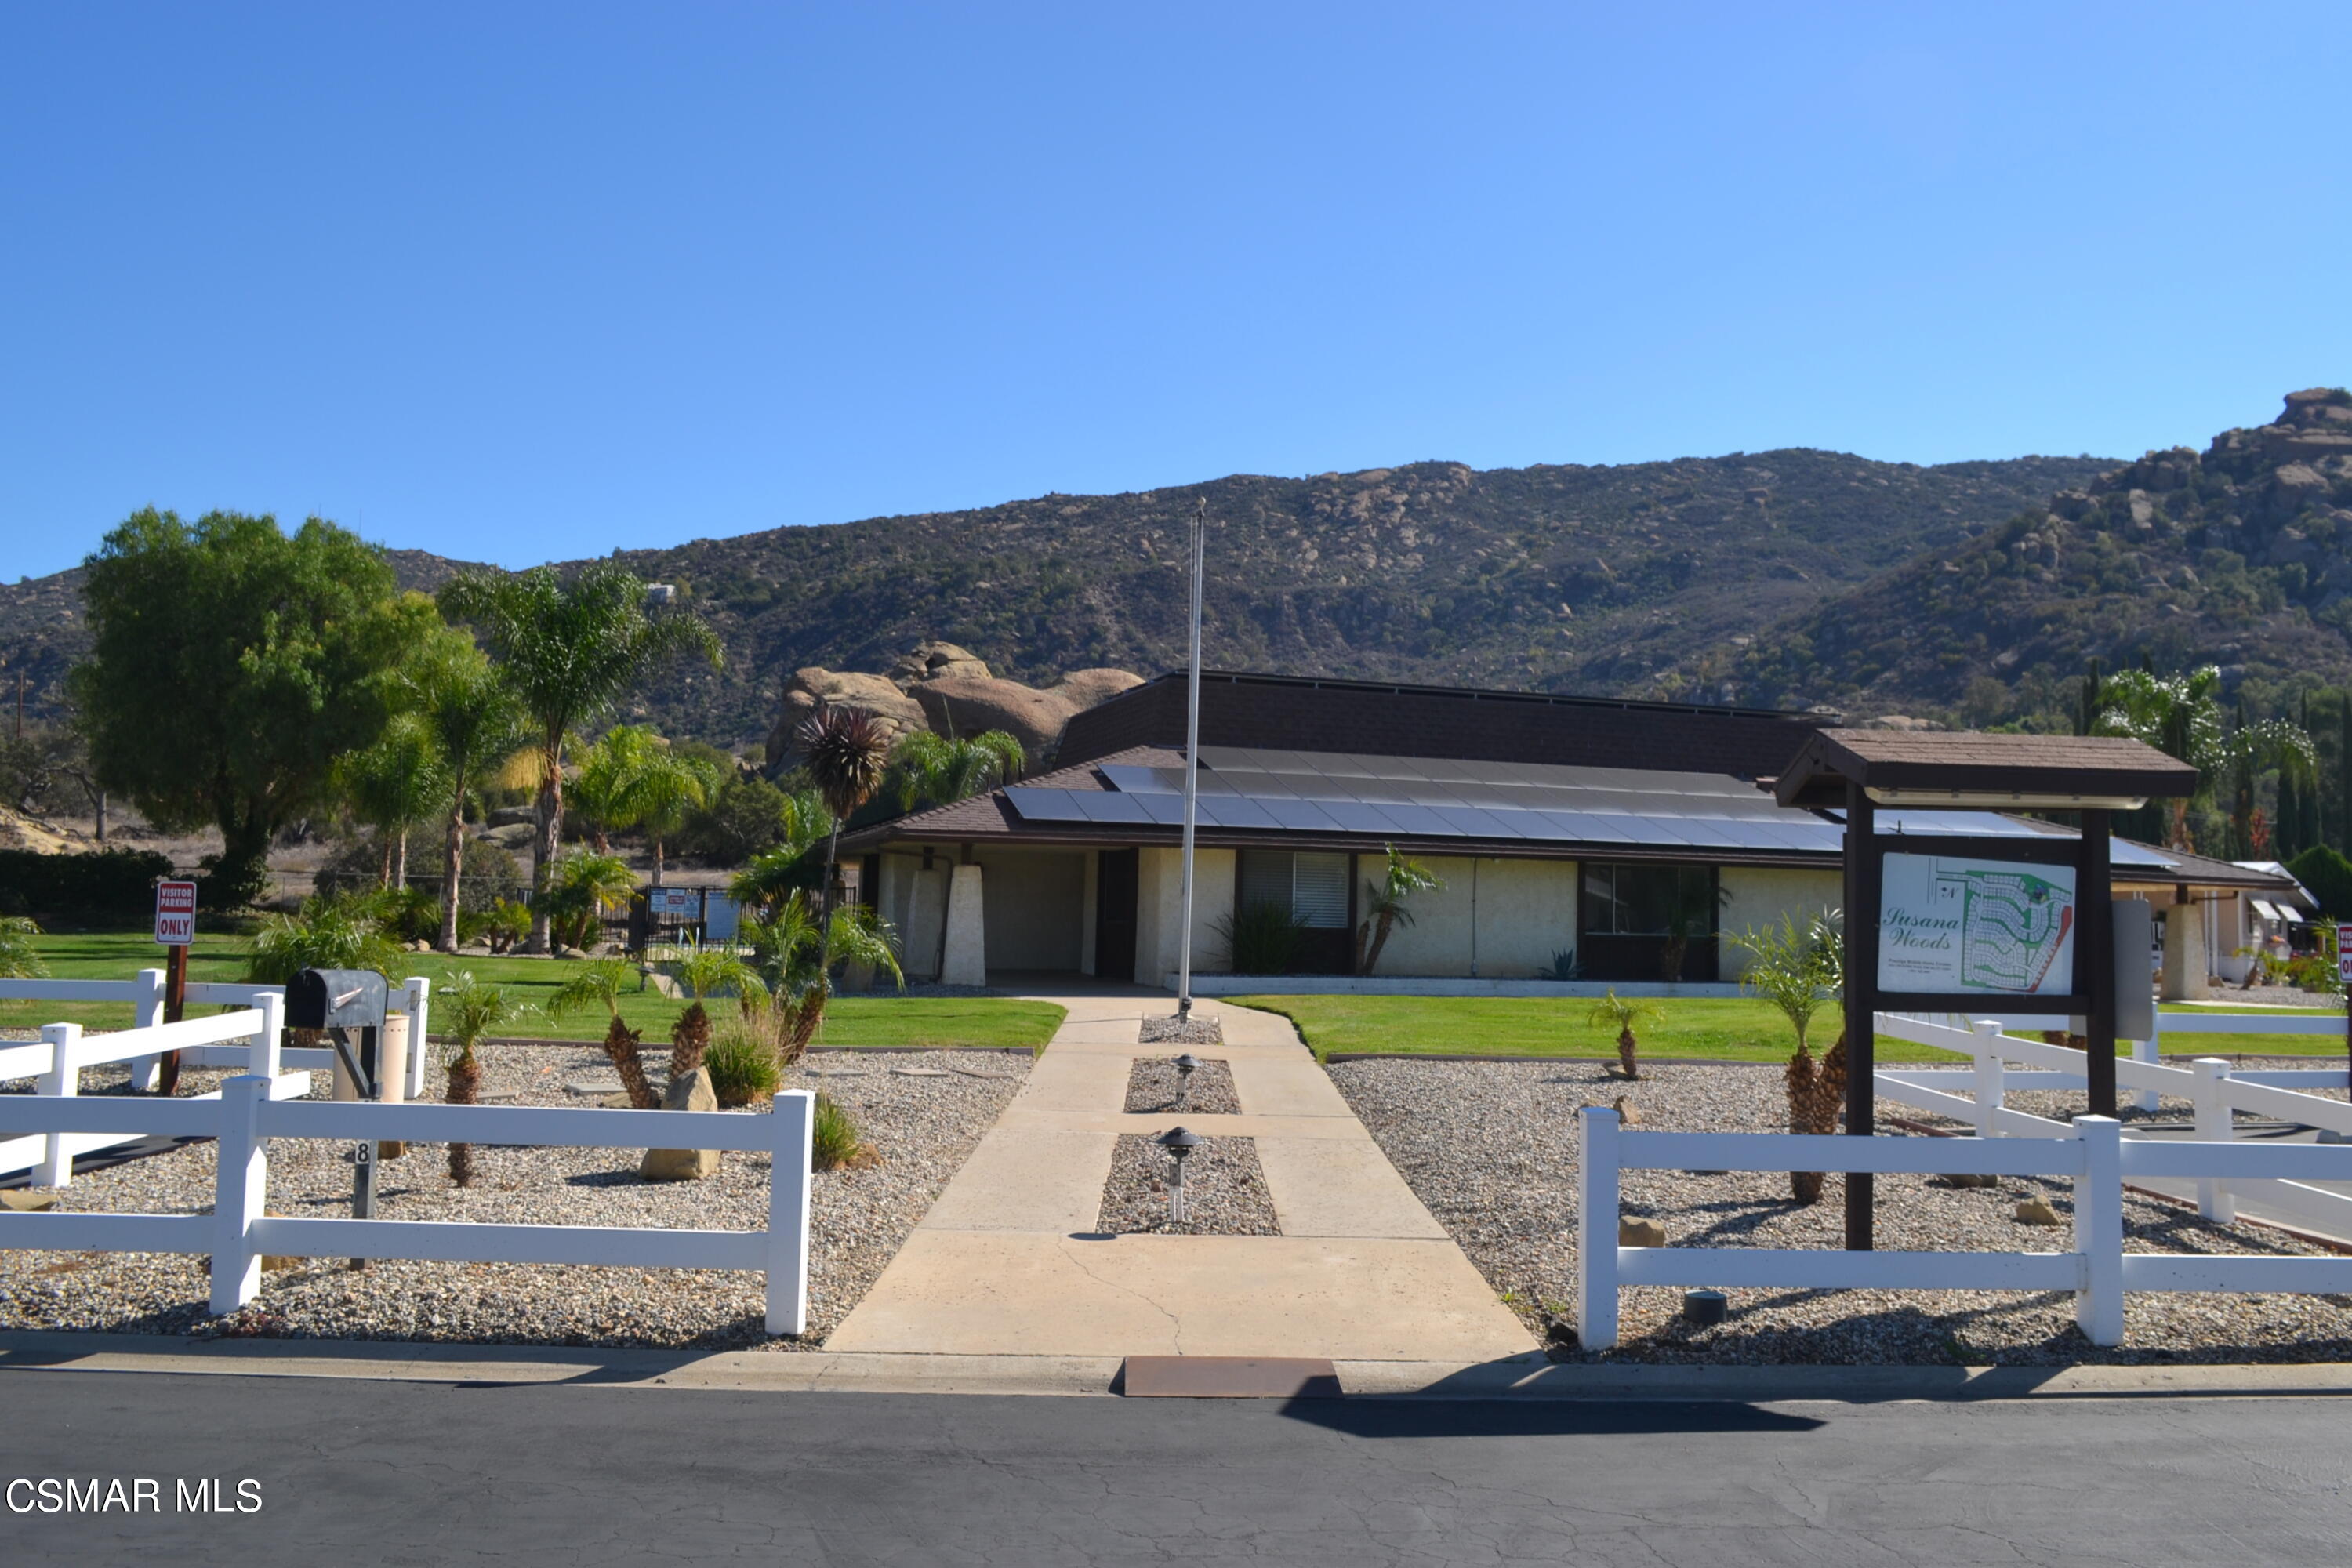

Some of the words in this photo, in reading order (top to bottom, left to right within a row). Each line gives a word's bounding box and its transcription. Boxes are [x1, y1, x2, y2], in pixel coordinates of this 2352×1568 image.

[162, 888, 193, 898] VISITOR
[161, 898, 193, 907] PARKING
[160, 919, 190, 935] ONLY
[1882, 907, 1959, 930] Susana
[1889, 927, 1951, 950] Woods
[358, 1143, 369, 1162] 8
